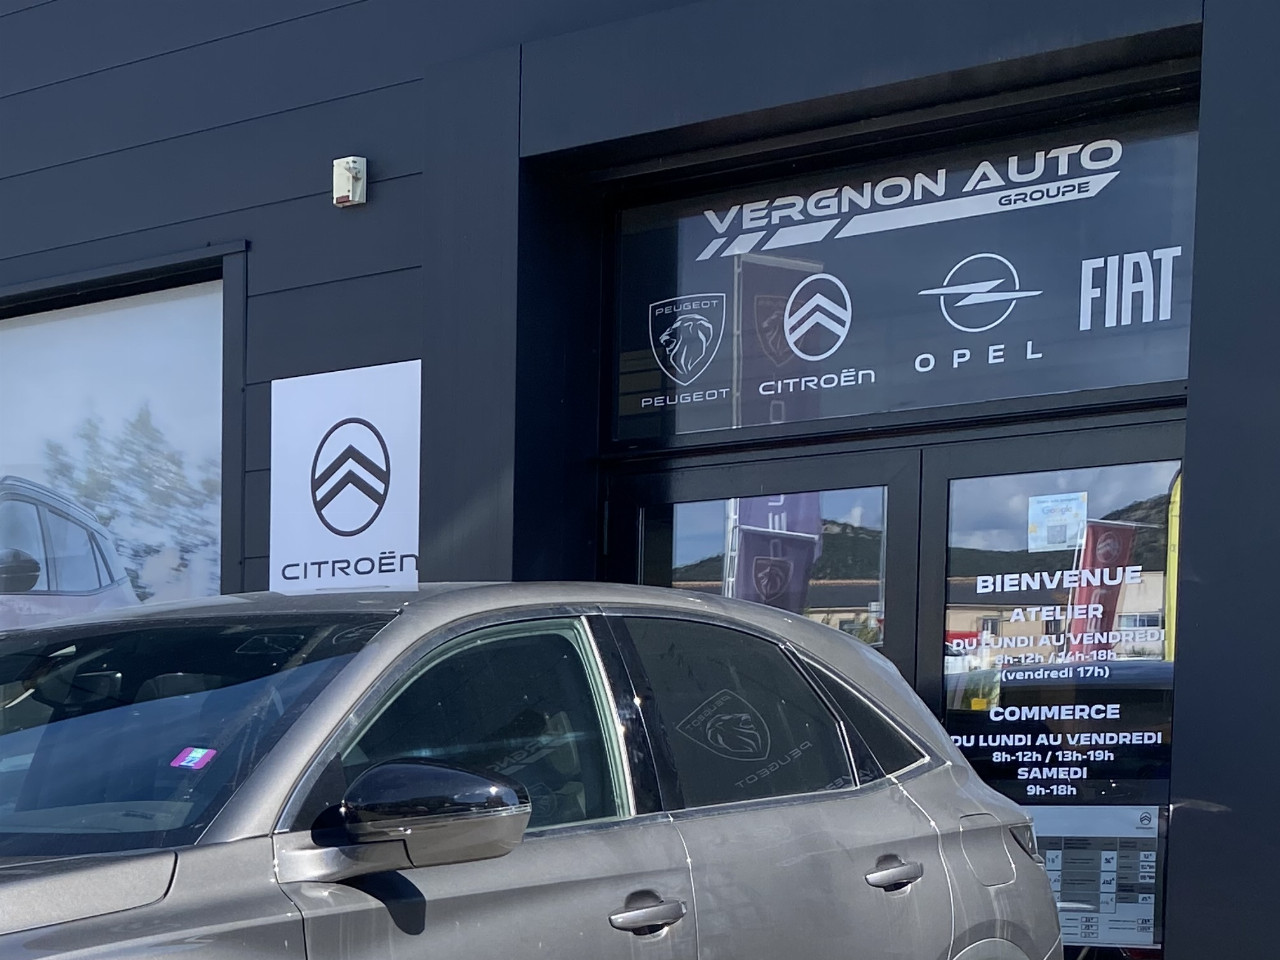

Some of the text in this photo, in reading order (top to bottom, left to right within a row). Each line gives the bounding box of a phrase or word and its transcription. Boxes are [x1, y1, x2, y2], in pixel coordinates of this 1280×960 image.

[703, 139, 1123, 235] VERGNON AUTO
[998, 180, 1091, 207] GROUPE
[1079, 246, 1182, 331] FIAT
[655, 299, 719, 316] PEUGEOT
[914, 340, 1043, 373] OPEL
[641, 388, 731, 408] PEUGEOT
[976, 565, 1143, 594] BIENVENUE
[1009, 603, 1104, 623] ATELIER
[952, 629, 1165, 651] DU LUNDI AU VENDREDI
[995, 652, 1044, 665] 8h-12h
[1001, 665, 1110, 682] (vendredi 17h)
[989, 703, 1121, 722] COMMERCE
[951, 731, 1163, 747] DU LUNDI AU VENDREDI
[992, 751, 1042, 763] 8h-12h
[1055, 749, 1115, 763] 13h-19h
[1017, 766, 1088, 780] SAMEDI
[1026, 783, 1077, 796] 9h-18h
